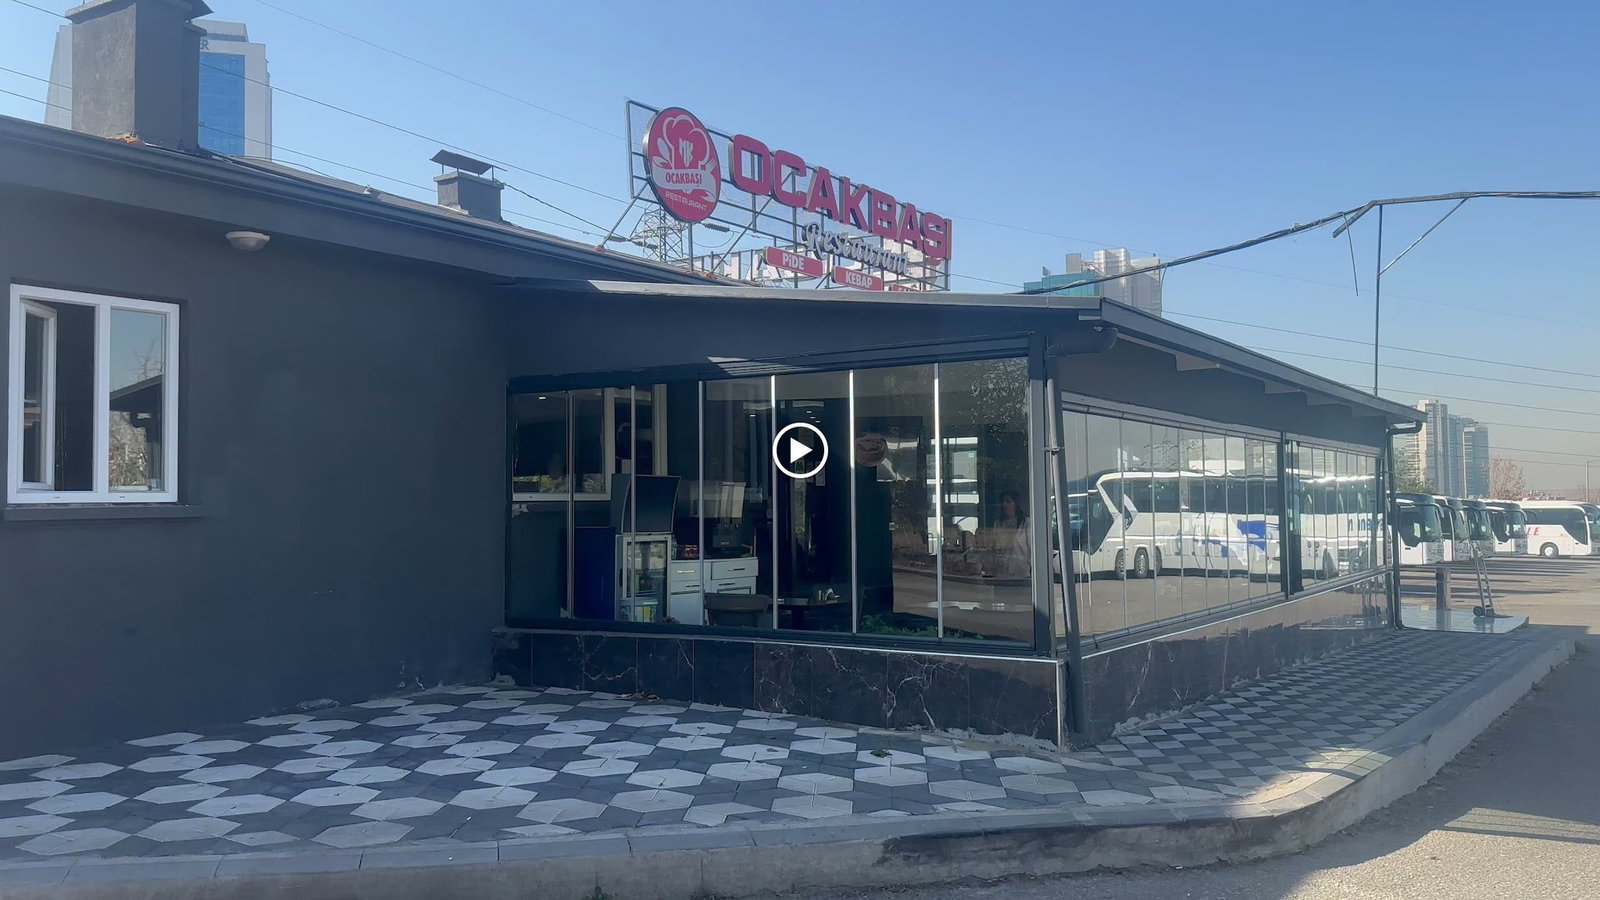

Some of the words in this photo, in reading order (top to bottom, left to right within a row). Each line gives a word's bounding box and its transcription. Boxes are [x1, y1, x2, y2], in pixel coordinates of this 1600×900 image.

[665, 172, 702, 188] OCAKBAŞI
[665, 191, 708, 211] RESTAURANT
[803, 222, 909, 275] Restaurant
[845, 271, 873, 289] KEBAP
